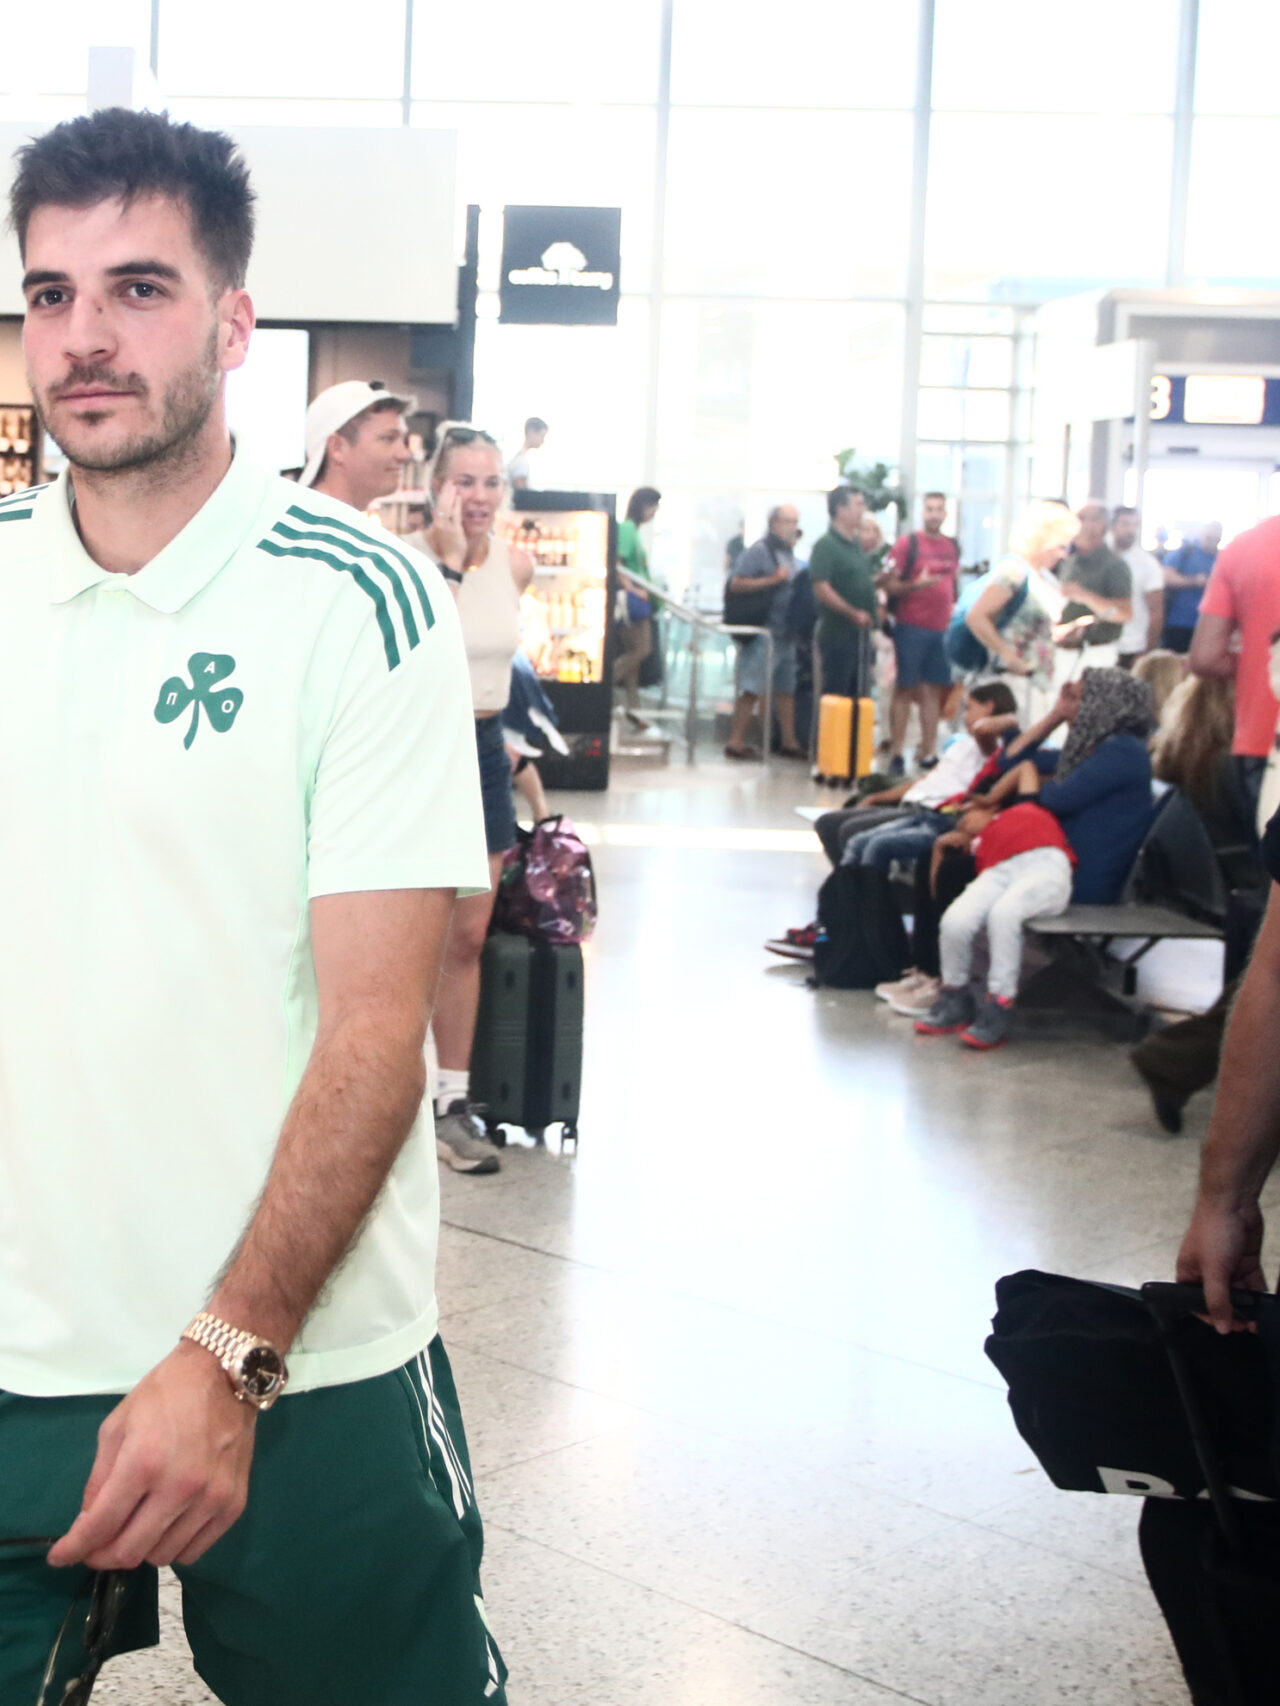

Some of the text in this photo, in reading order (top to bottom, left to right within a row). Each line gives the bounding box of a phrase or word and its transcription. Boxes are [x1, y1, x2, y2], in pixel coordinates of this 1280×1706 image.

[1149, 374, 1172, 420] 3
[166, 661, 234, 713] Π Α Ο
